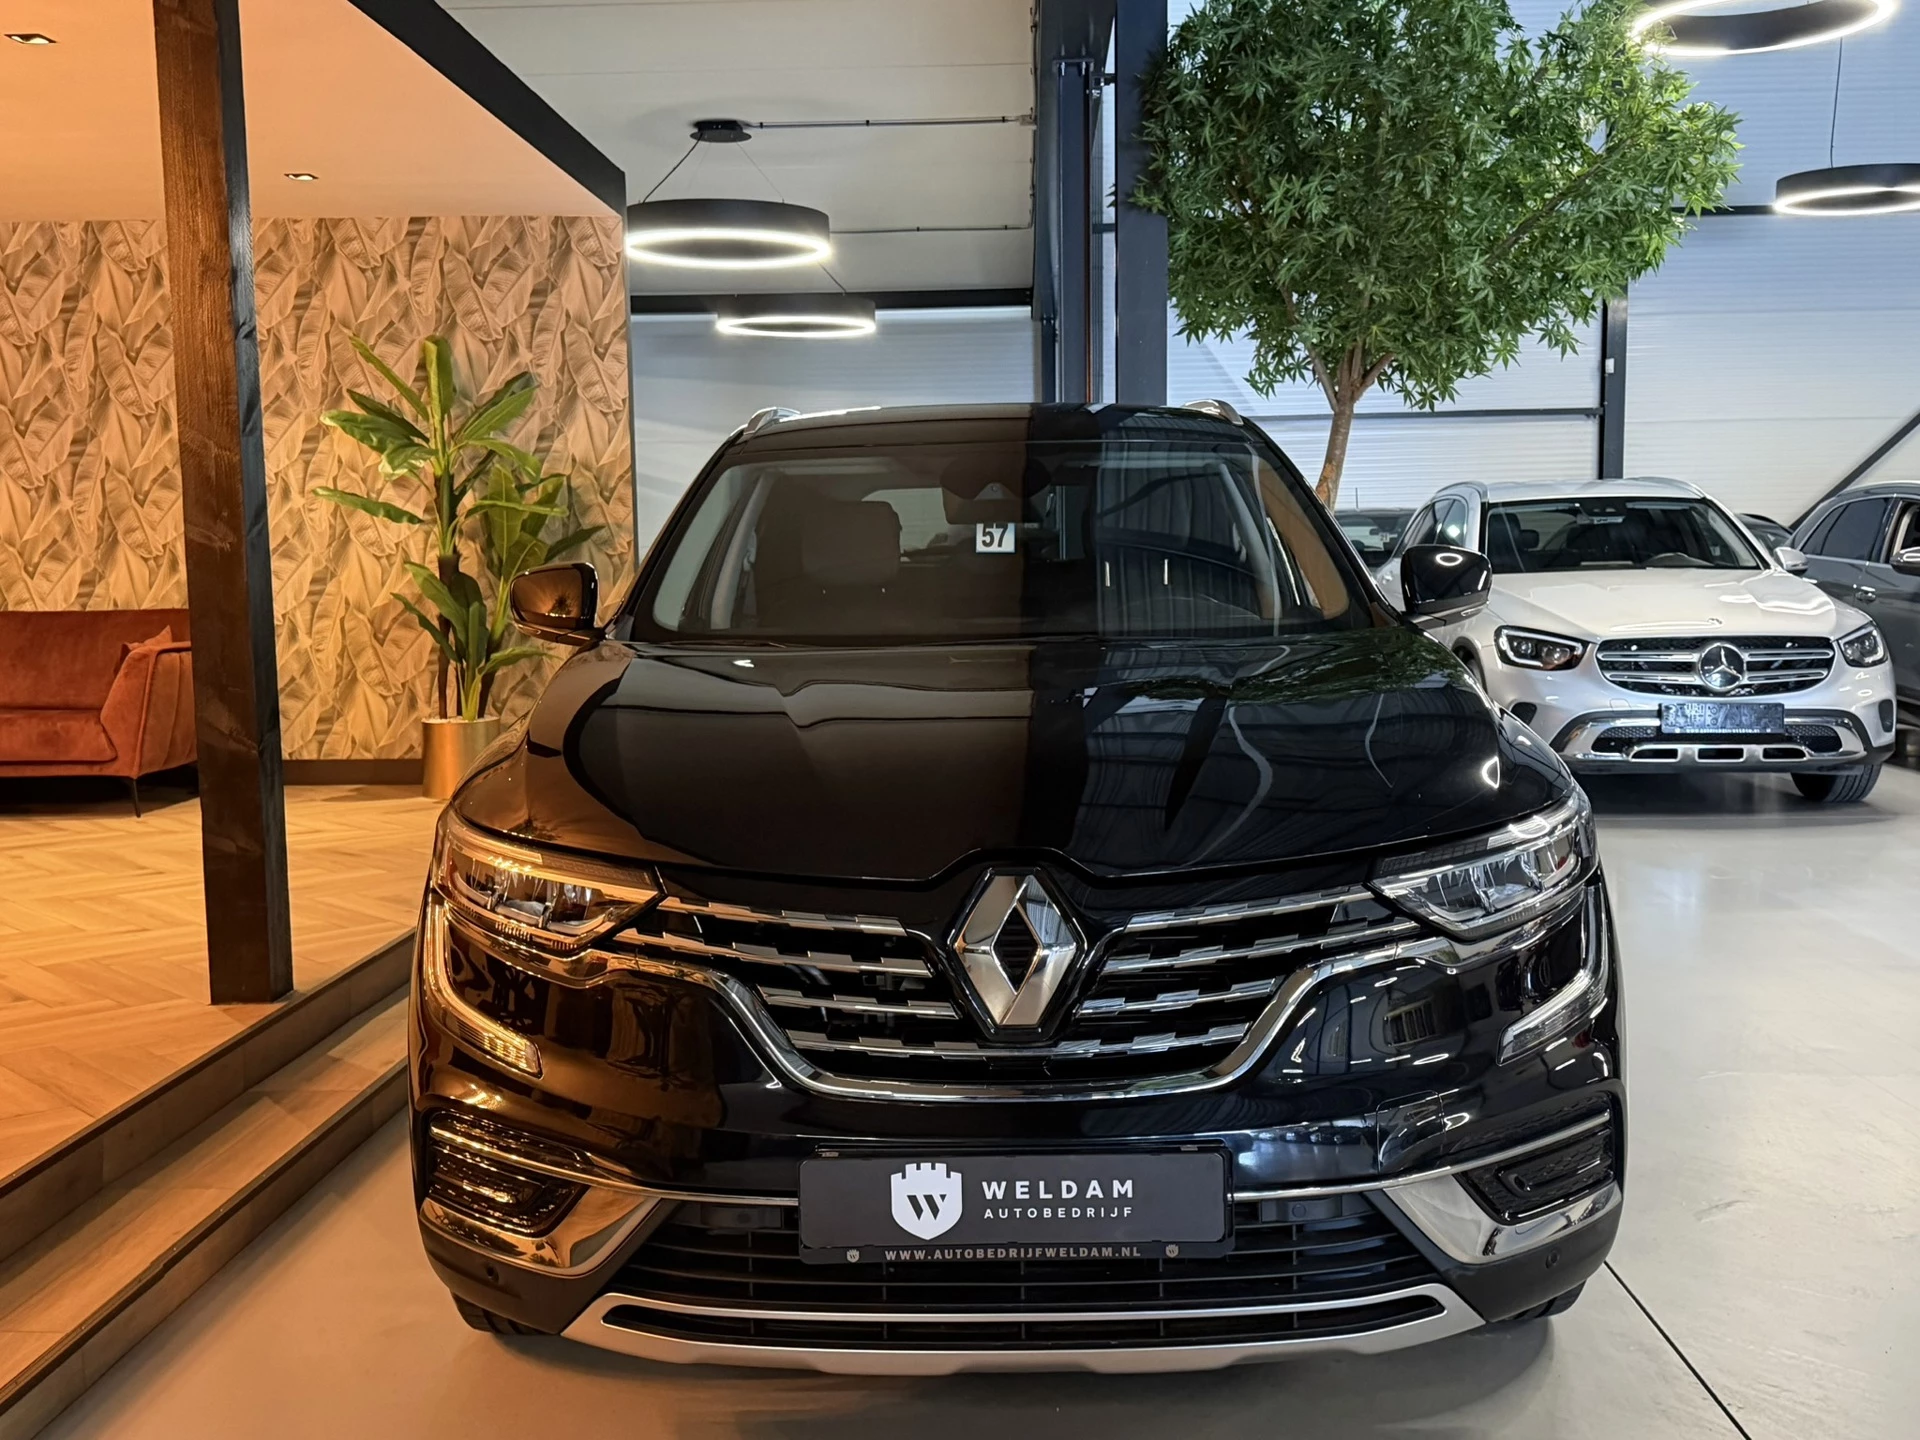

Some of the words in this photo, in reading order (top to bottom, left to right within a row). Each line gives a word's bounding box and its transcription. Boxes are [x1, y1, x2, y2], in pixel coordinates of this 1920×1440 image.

[981, 523, 1008, 548] 57
[982, 1180, 1133, 1200] WELDAM
[984, 1207, 1133, 1219] AUTOBEDRIJF
[885, 1247, 1142, 1261] WWW.AUTOBEDRIJFWELDAM.NL
